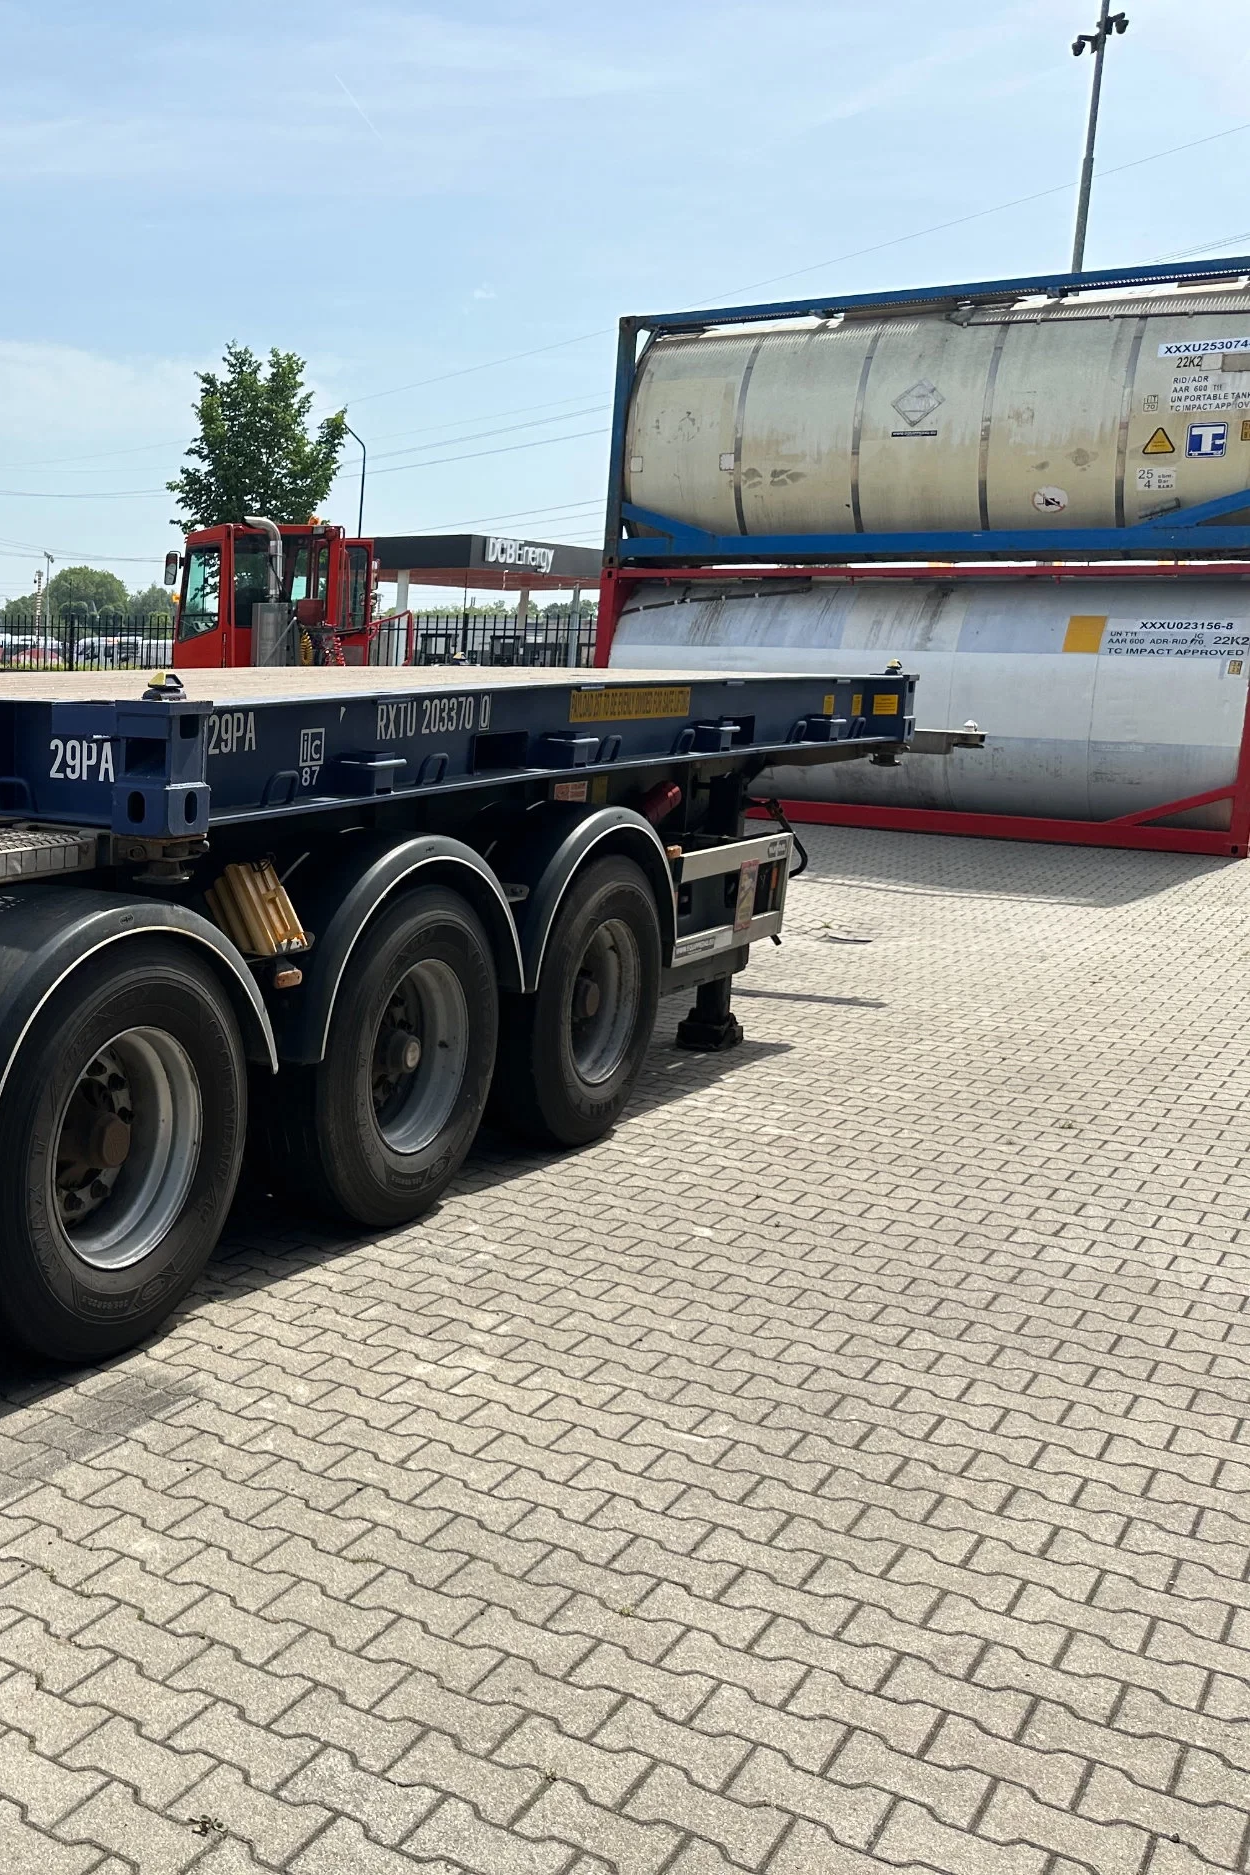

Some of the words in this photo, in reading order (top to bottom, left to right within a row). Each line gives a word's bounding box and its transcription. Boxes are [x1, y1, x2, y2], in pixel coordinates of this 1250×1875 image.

[1172, 375, 1209, 384] RID/ADR
[1172, 385, 1190, 394] AAR
[1193, 384, 1208, 393] 600
[1170, 395, 1183, 403] UN
[1183, 392, 1229, 402] PORTABLE
[1182, 403, 1212, 412] IMPACT
[1138, 468, 1154, 480] 25
[1143, 479, 1152, 489] 4
[485, 537, 554, 573] DCBEnergy
[1139, 621, 1234, 630] XXXU023156-8
[1213, 636, 1250, 646] 22K2
[1107, 647, 1123, 655] TC
[1174, 648, 1245, 656] APPROVED
[376, 701, 417, 740] RXTU
[421, 696, 474, 735] 203370
[207, 711, 256, 755] 29PA
[49, 738, 115, 784] 29PA
[301, 765, 320, 787] 87
